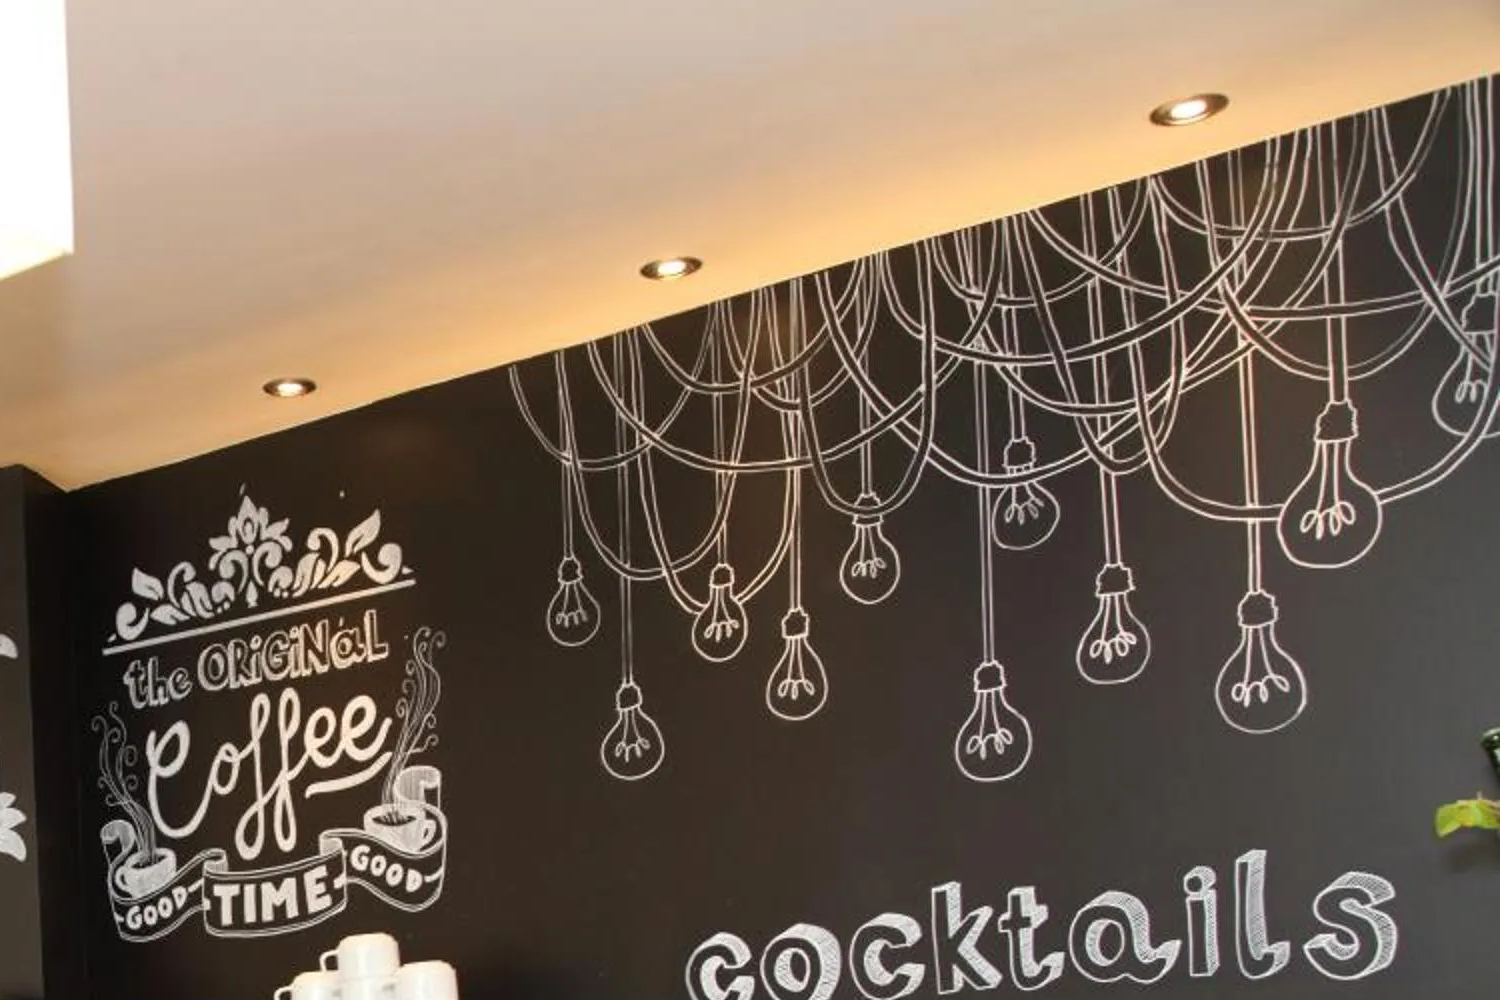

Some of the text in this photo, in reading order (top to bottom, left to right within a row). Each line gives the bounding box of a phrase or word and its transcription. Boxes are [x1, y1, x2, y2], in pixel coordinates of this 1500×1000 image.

[123, 656, 194, 709] the
[144, 687, 393, 861] Coffee
[126, 845, 424, 931] GOOD TIME GOOD
